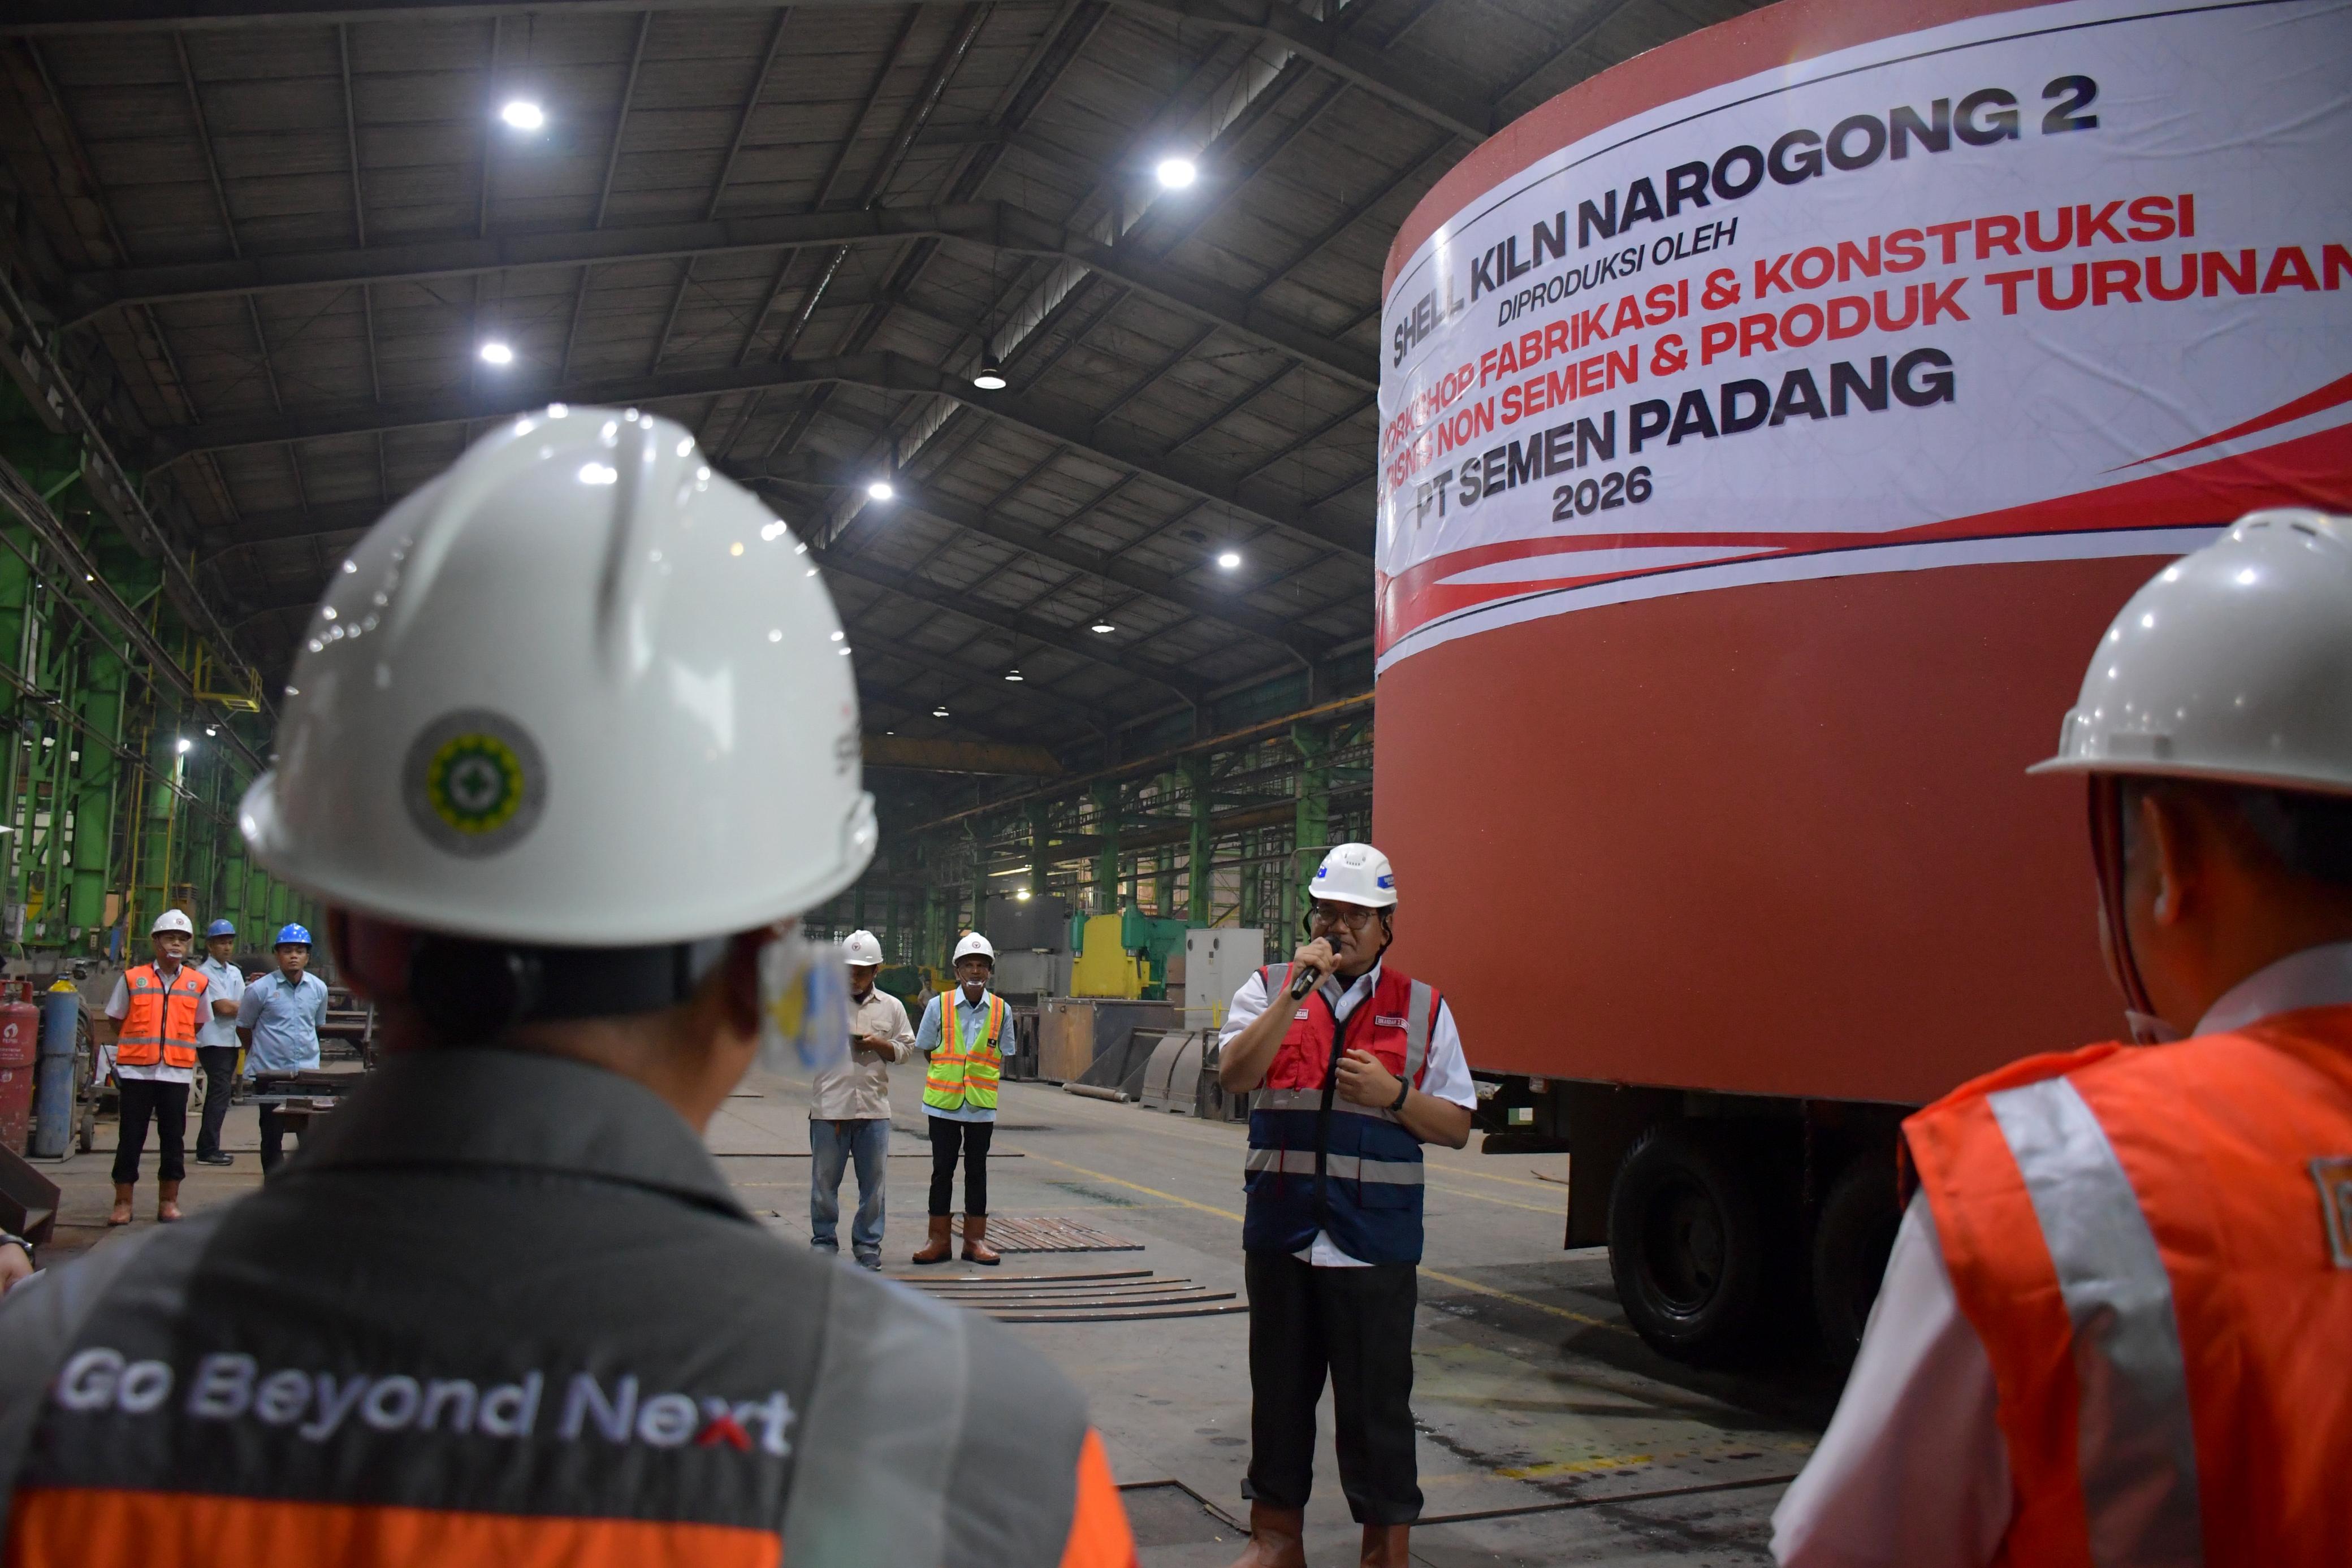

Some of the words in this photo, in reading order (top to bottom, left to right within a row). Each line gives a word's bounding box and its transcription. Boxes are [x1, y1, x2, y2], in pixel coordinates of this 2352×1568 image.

[1394, 275, 1464, 369] SHELL
[1471, 211, 1566, 302] KILN
[1578, 88, 2022, 249] NAROGONG
[2042, 75, 2102, 135] 2
[1480, 279, 1689, 389] FABRIKASI
[1701, 268, 1741, 310] &
[1755, 194, 2195, 299] KONSTRUKSI
[1498, 244, 1645, 327] DIPRODUKSI
[1651, 217, 1739, 266] OLEH
[1417, 469, 1453, 529] PT
[1459, 409, 1615, 507] SEMEN
[1629, 347, 1956, 454] PADANG
[1438, 396, 1494, 457] NON
[1501, 344, 1638, 425] SEMEN
[1650, 333, 1688, 376] &
[1701, 278, 1970, 366] PRODUK
[1552, 465, 1653, 522] 2026
[55, 1346, 174, 1414] Go
[187, 1353, 544, 1442] Beyond
[560, 1372, 796, 1456] Next
